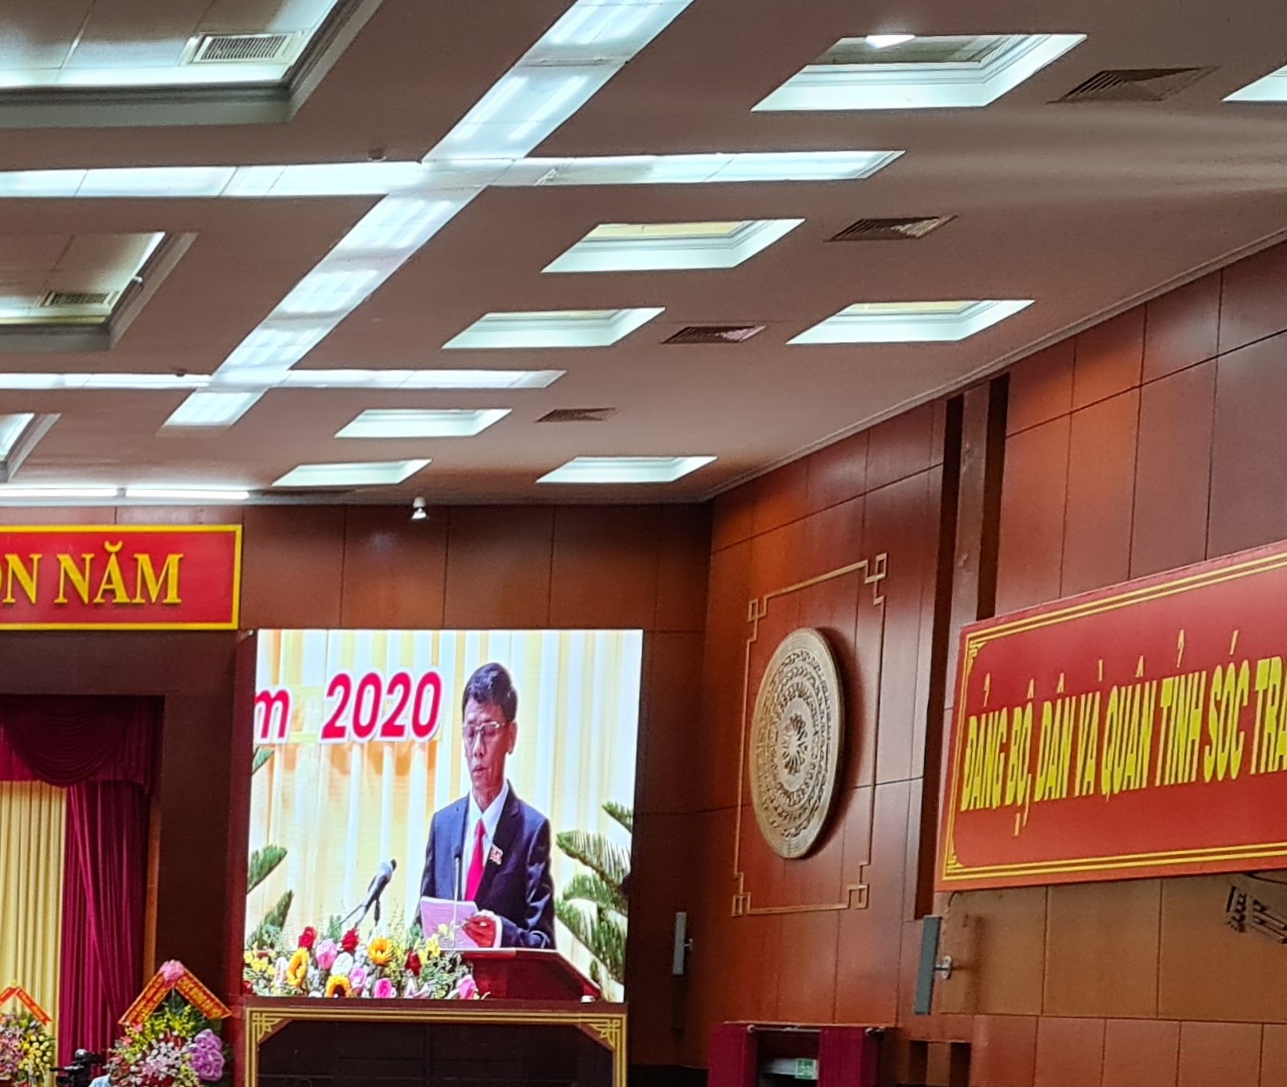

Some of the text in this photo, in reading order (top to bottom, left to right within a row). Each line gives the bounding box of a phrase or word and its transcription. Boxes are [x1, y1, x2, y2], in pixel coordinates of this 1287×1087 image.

[54, 540, 184, 605] NĂM
[321, 671, 442, 740] 2020
[960, 672, 1008, 812] ĐẢNG
[1034, 672, 1076, 802] DÂN
[1074, 659, 1103, 798] VÀ
[1101, 655, 1157, 803] QUÂN
[1155, 629, 1207, 787] TỈNH
[1203, 629, 1250, 783] SÓC
